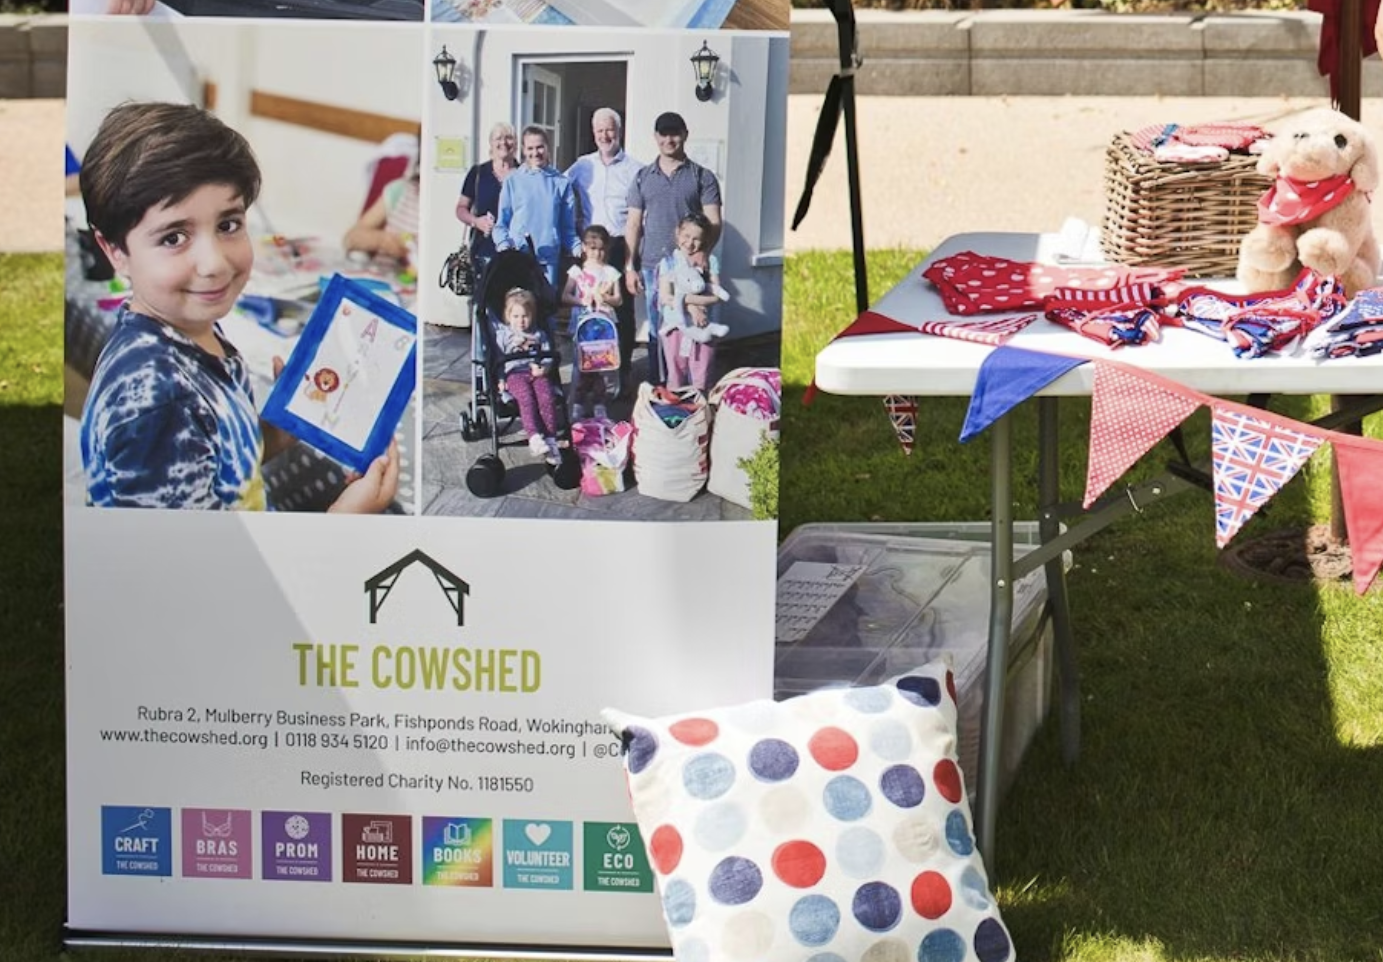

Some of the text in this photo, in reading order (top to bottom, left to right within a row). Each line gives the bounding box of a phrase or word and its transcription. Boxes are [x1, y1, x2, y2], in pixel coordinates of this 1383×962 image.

[292, 642, 542, 694] THE COWSHED
[137, 705, 183, 722] Rubra
[187, 707, 201, 724] 2,
[205, 708, 273, 729] Mulberry
[276, 710, 346, 728] Business
[349, 713, 390, 730] Park,
[394, 714, 475, 734] Fishponds
[478, 716, 522, 735] Road,
[99, 728, 268, 750] www.thecowshed.org
[285, 732, 317, 748] 0118
[320, 733, 349, 749] 934
[353, 734, 389, 751] 5120
[405, 735, 576, 760] info@thecowshed.org
[300, 771, 534, 794] Registered Charity No. 1181550
[114, 837, 159, 853] CRAFT
[196, 840, 238, 856] BRAS
[275, 842, 319, 858] PROM
[356, 845, 399, 861] HOME
[433, 847, 483, 863] BOOKS
[506, 849, 571, 867] VOLUNTEER
[603, 852, 634, 869] ECO
